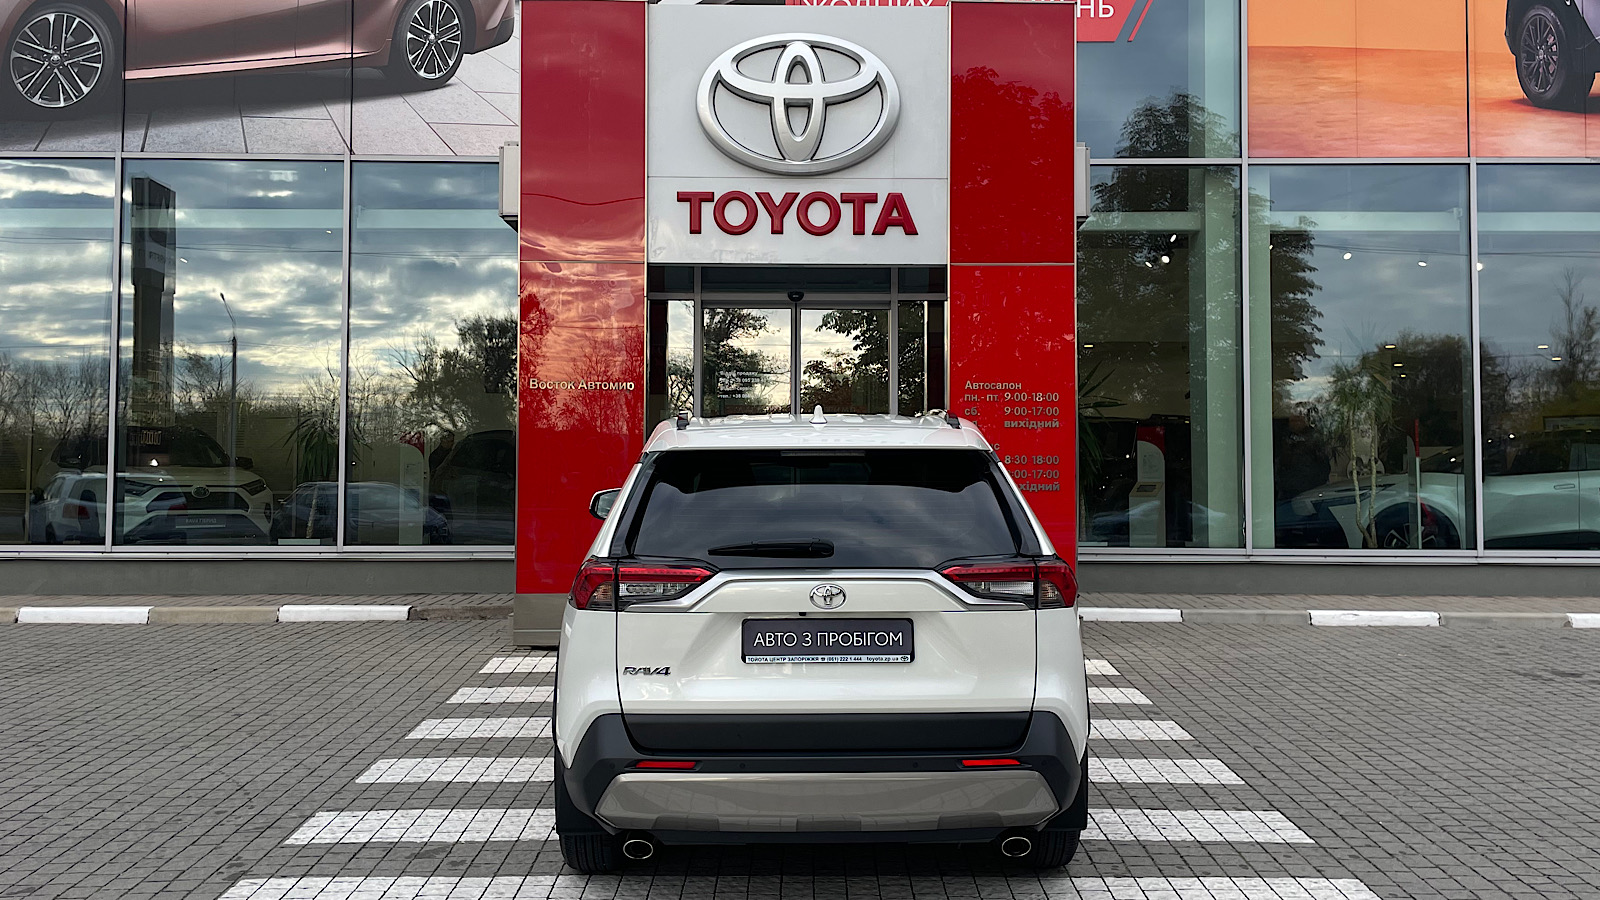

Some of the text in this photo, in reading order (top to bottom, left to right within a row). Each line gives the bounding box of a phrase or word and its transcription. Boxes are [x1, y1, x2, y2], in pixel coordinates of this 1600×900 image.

[677, 190, 919, 236] TOYOTA
[529, 378, 635, 391] Восток Автомир
[964, 380, 1022, 390] Автосалон
[964, 406, 1060, 416] сб. 9:00-17:00
[1004, 418, 1060, 430] вихідний
[1008, 469, 1060, 479] :00-17:00
[1018, 481, 1060, 492] хідний
[753, 632, 798, 647] АВТО
[817, 631, 903, 647] ПРОБІГОМ
[622, 666, 672, 676] RAV4
